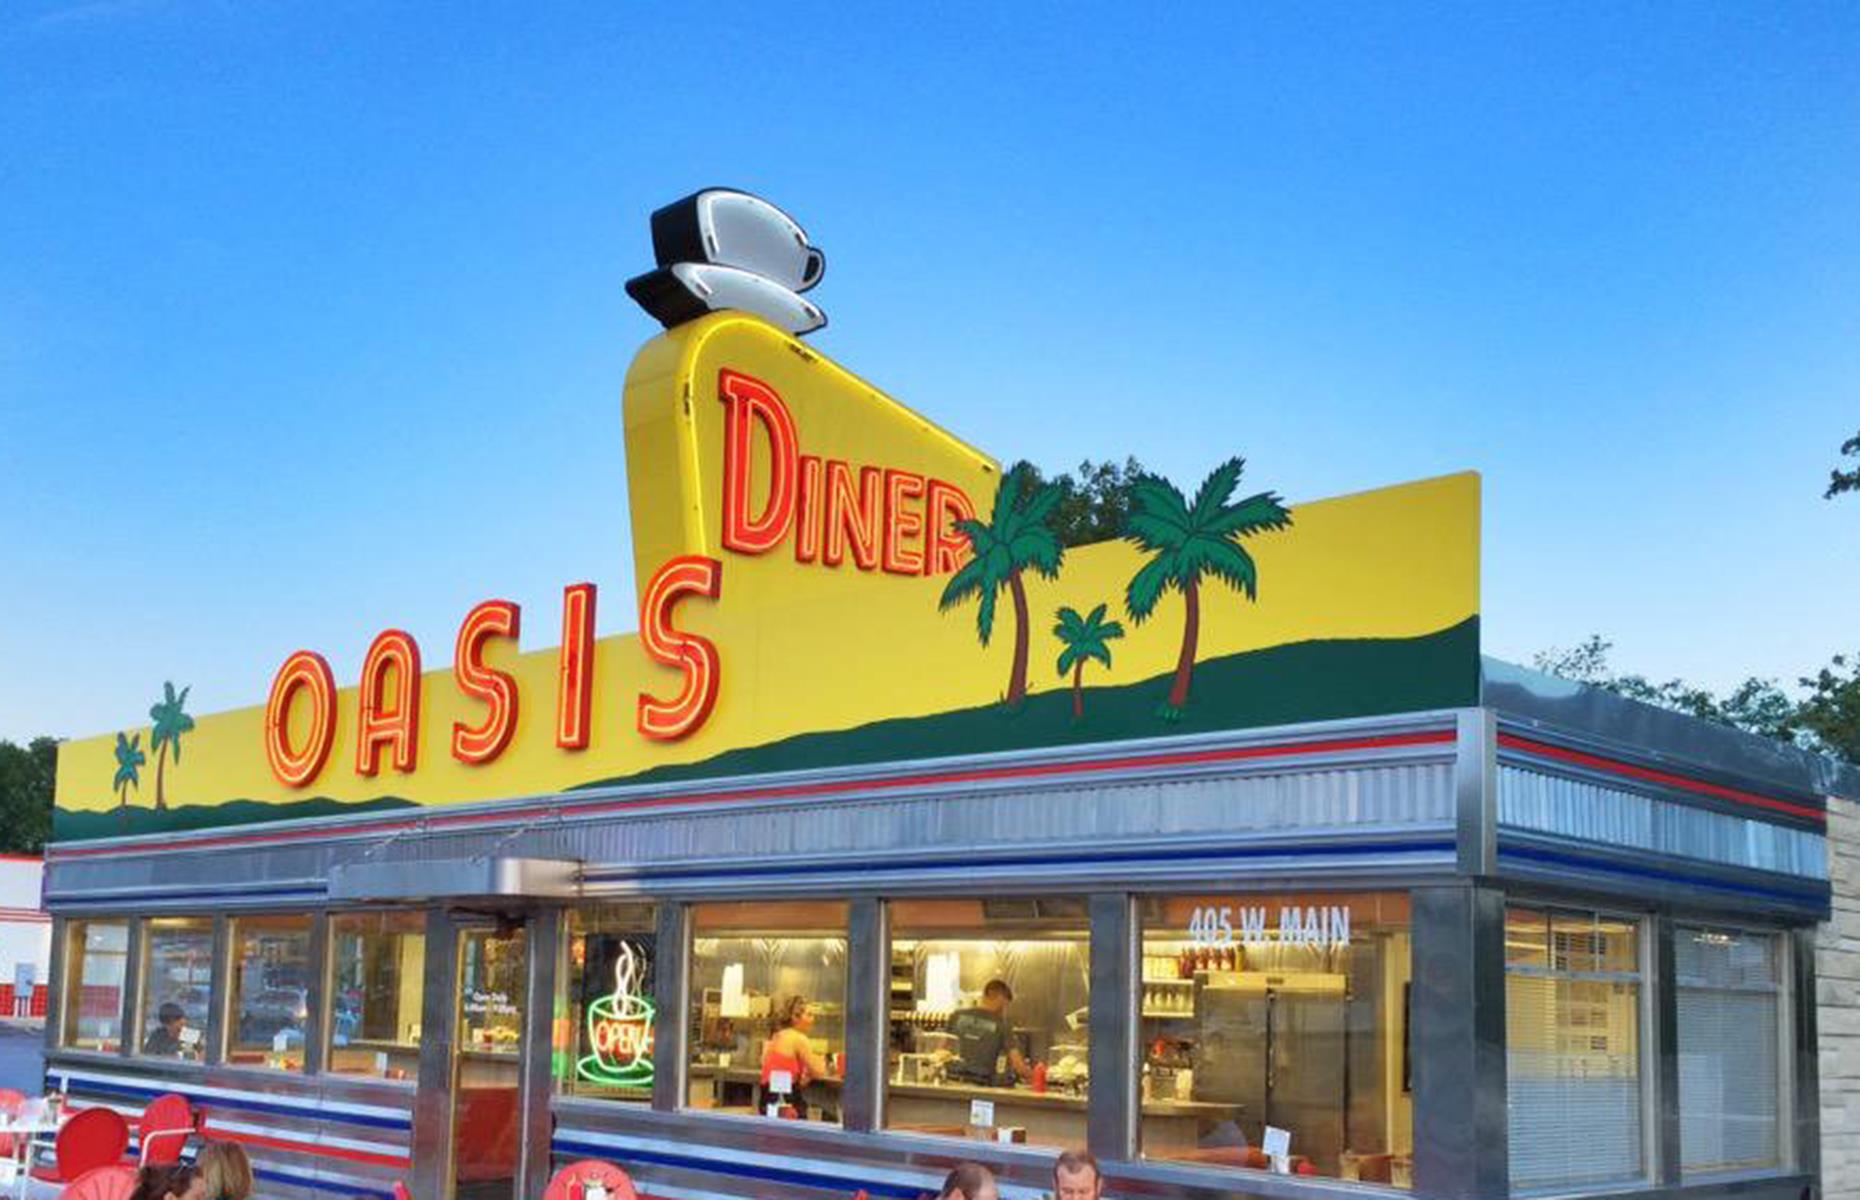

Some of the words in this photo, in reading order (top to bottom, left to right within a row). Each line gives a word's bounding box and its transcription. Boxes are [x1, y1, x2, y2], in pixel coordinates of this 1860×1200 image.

[719, 367, 977, 576] DINER
[265, 555, 722, 788] OASIS
[1189, 906, 1233, 946] 405
[1279, 906, 1350, 947] MAIN
[596, 1021, 643, 1054] OPEN
